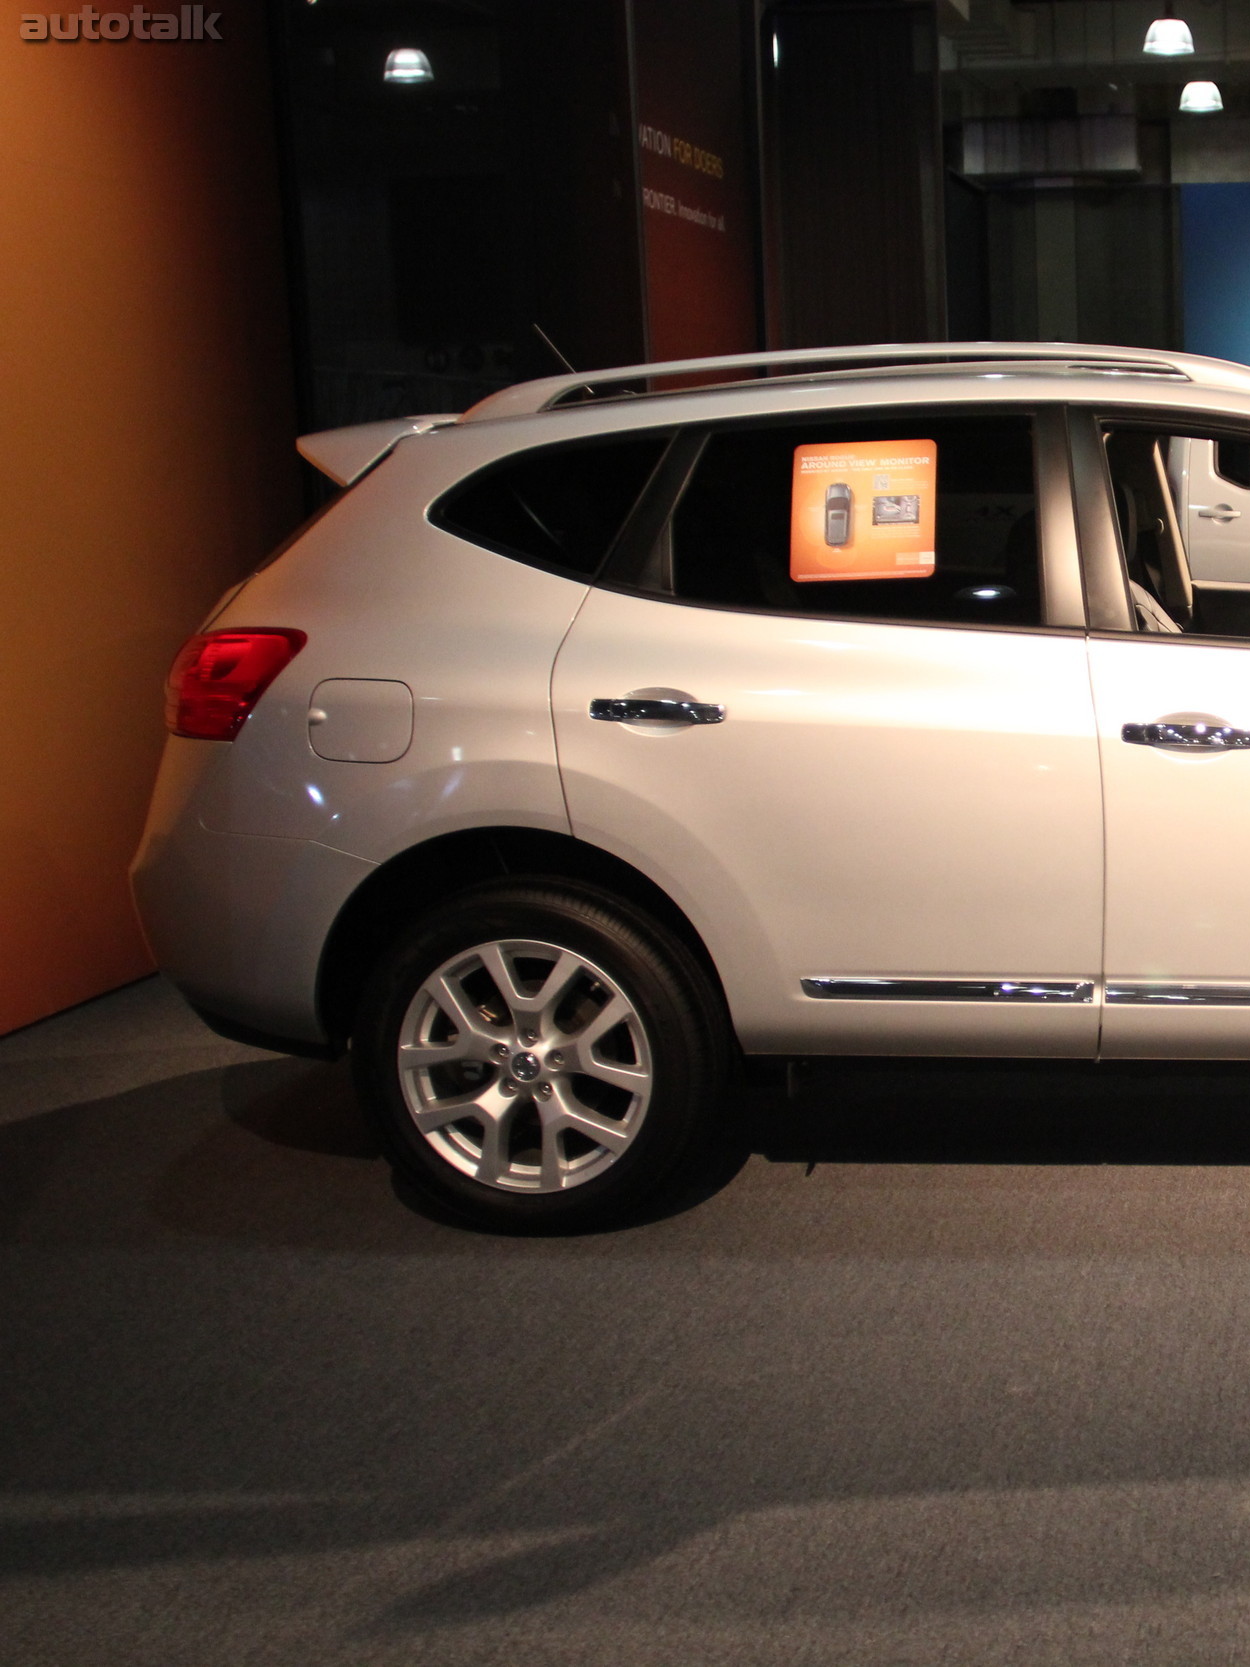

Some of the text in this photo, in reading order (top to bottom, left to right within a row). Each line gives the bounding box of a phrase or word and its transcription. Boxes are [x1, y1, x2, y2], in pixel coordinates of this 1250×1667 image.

[801, 461, 847, 470] AROUND
[849, 459, 876, 467] VIEW
[880, 456, 930, 466] MONITOR
